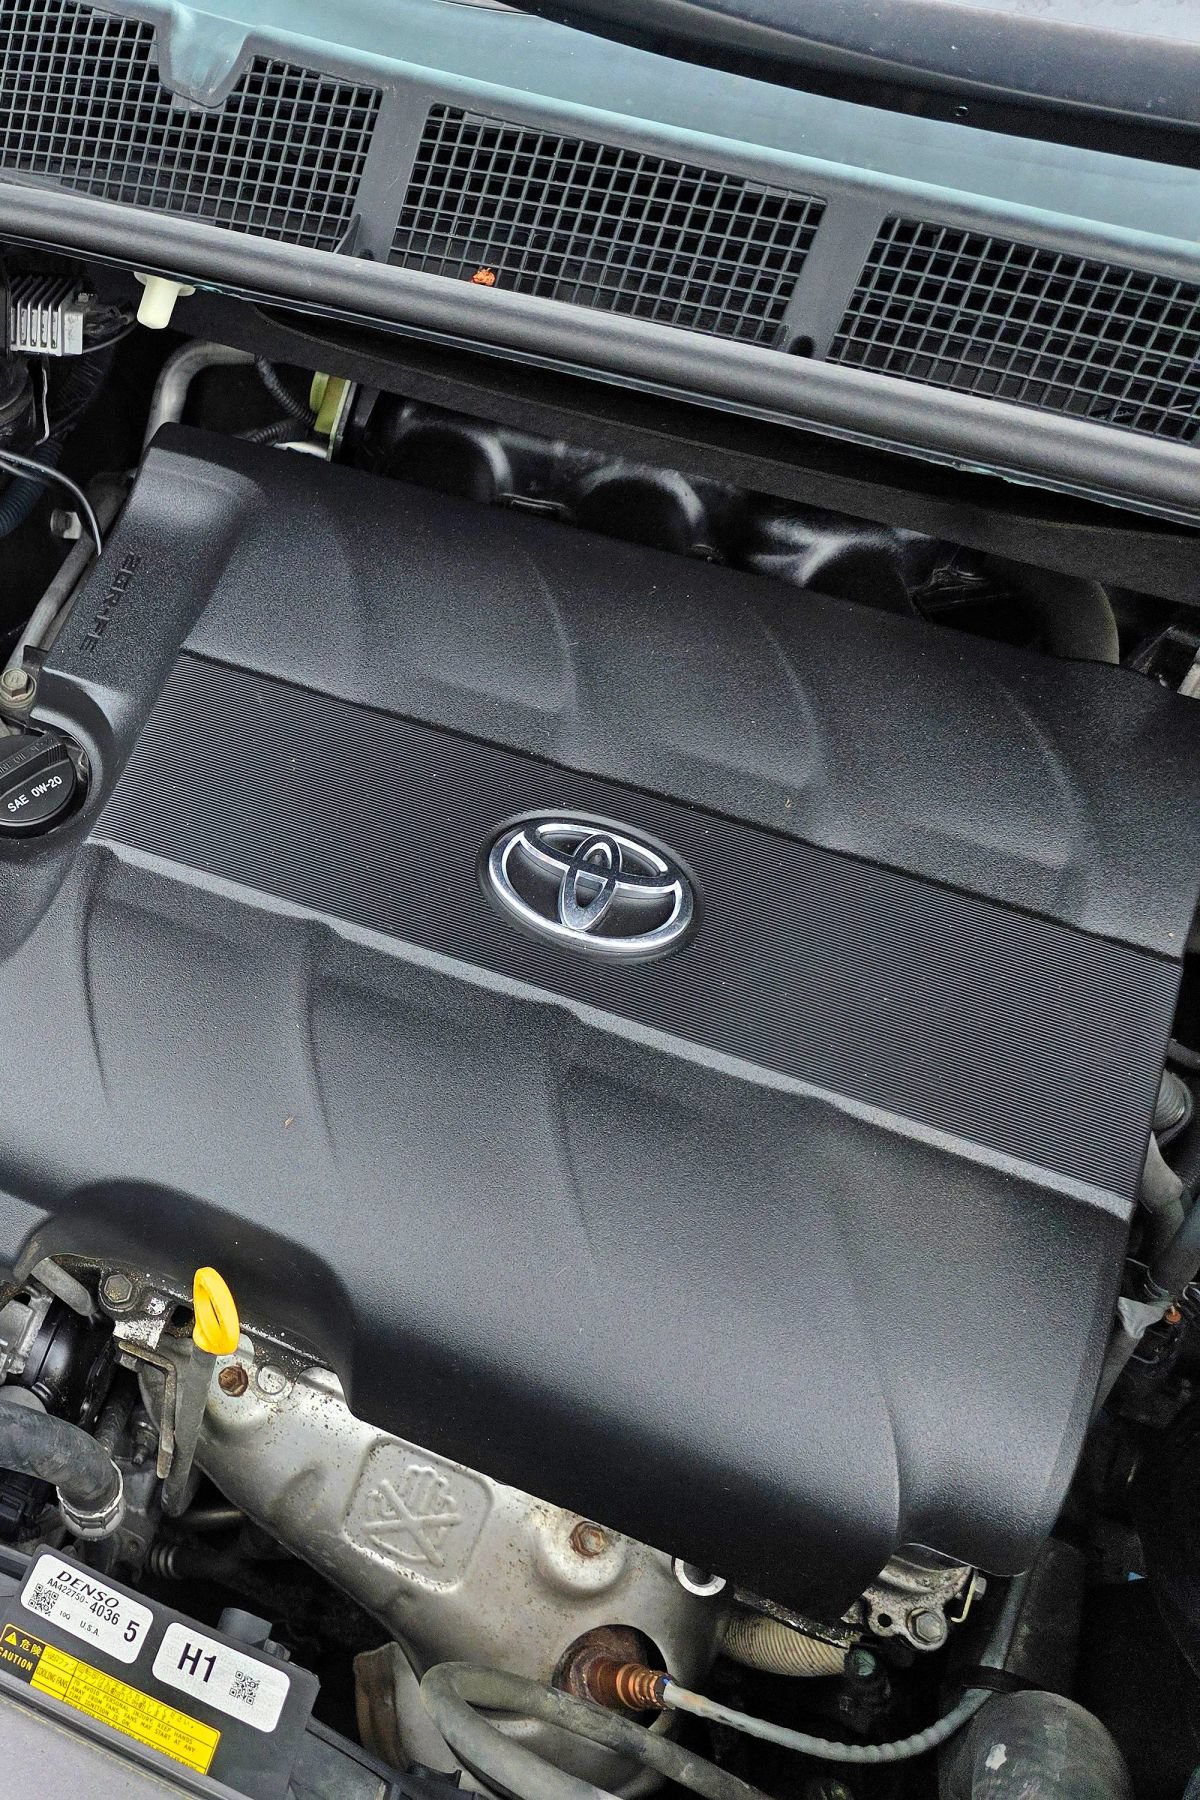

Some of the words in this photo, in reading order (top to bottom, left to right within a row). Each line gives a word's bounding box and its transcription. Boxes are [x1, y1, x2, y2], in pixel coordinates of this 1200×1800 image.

[7, 794, 30, 813] SAE
[31, 775, 63, 798] 0W-20
[56, 1571, 121, 1611] DENSO
[79, 1621, 100, 1637] U.S.A.
[123, 1620, 141, 1644] 5
[19, 1638, 44, 1658] 危険
[177, 1642, 217, 1683] H1
[35, 1666, 58, 1683] COOLING
[55, 1677, 70, 1690] FANS
[68, 1691, 82, 1702] TIME
[84, 1700, 110, 1717] IGNITION
[71, 1685, 86, 1696] AWAY
[87, 1694, 103, 1705] FROM
[123, 1713, 138, 1724] FANS
[140, 1722, 152, 1731] MAY
[154, 1729, 171, 1741] START
[173, 1739, 182, 1747] AT
[183, 1744, 196, 1754] ANY
[83, 1684, 101, 1696] AVOID
[102, 1694, 130, 1712] PERSONAL
[157, 1723, 171, 1733] KEEP
[173, 1731, 194, 1745] HANDS
